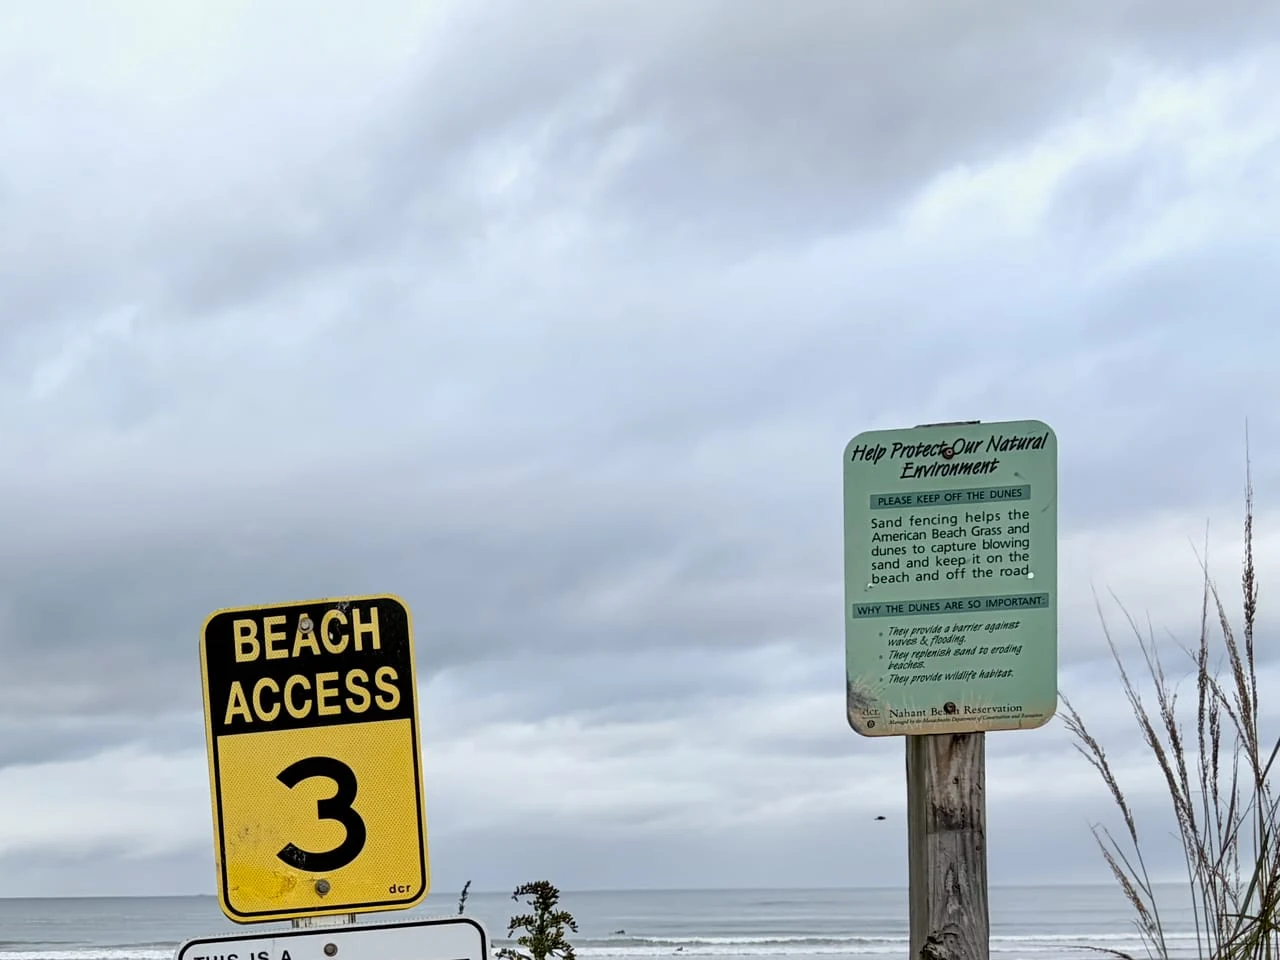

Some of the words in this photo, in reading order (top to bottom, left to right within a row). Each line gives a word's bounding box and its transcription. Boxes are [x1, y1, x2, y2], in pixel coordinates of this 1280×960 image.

[851, 443, 887, 465] Help
[890, 440, 948, 459] Protect
[951, 438, 984, 455] Our
[985, 432, 1049, 453] Natural
[900, 458, 1000, 479] Environment
[878, 495, 912, 506] PLEASE
[916, 493, 940, 504] KEEP
[944, 492, 962, 501] OFF
[966, 490, 984, 500] THE
[990, 488, 1022, 499] DUNES
[871, 516, 902, 529] Sand
[909, 513, 958, 527] fencing
[965, 511, 1001, 525] helps
[1008, 509, 1030, 521] the
[871, 530, 927, 543] American
[931, 527, 967, 540] Beach
[971, 525, 1002, 537] Grass
[1007, 523, 1030, 535] and
[871, 545, 907, 557] dunes
[912, 544, 926, 554] to
[931, 541, 977, 555] capture
[982, 537, 1030, 551] blowing
[871, 558, 900, 571] sand
[906, 556, 929, 568] and
[935, 555, 966, 568] keep
[972, 553, 981, 564] it
[986, 553, 1003, 564] on
[1009, 551, 1029, 562] the
[871, 572, 910, 585] beach
[915, 570, 940, 582] and
[946, 567, 966, 580] off
[972, 567, 993, 579] the
[857, 605, 881, 615] WHY
[885, 604, 904, 614] THE
[908, 602, 940, 613] DUNES
[944, 600, 964, 610] ARE
[968, 599, 981, 609] SO
[233, 607, 381, 663] BEACH
[888, 626, 909, 638] They
[910, 624, 943, 637] provide
[952, 623, 983, 632] barrier
[984, 620, 1021, 633] against
[888, 637, 918, 646] waves
[919, 635, 929, 647] &
[930, 634, 967, 647] flooding.
[888, 649, 909, 661] They
[910, 647, 951, 661] replenish
[952, 645, 977, 656] sand
[978, 645, 988, 655] to
[990, 644, 1023, 656] eroding
[888, 660, 925, 670] beaches.
[888, 674, 909, 686] They
[910, 672, 943, 685] provide
[944, 670, 977, 682] wildlife
[978, 668, 1014, 679] habitat.
[224, 666, 401, 725] ACCESS
[888, 707, 926, 718] Nahant
[963, 703, 1023, 715] Reservation
[276, 756, 367, 873] 3
[388, 882, 411, 894] dcr
